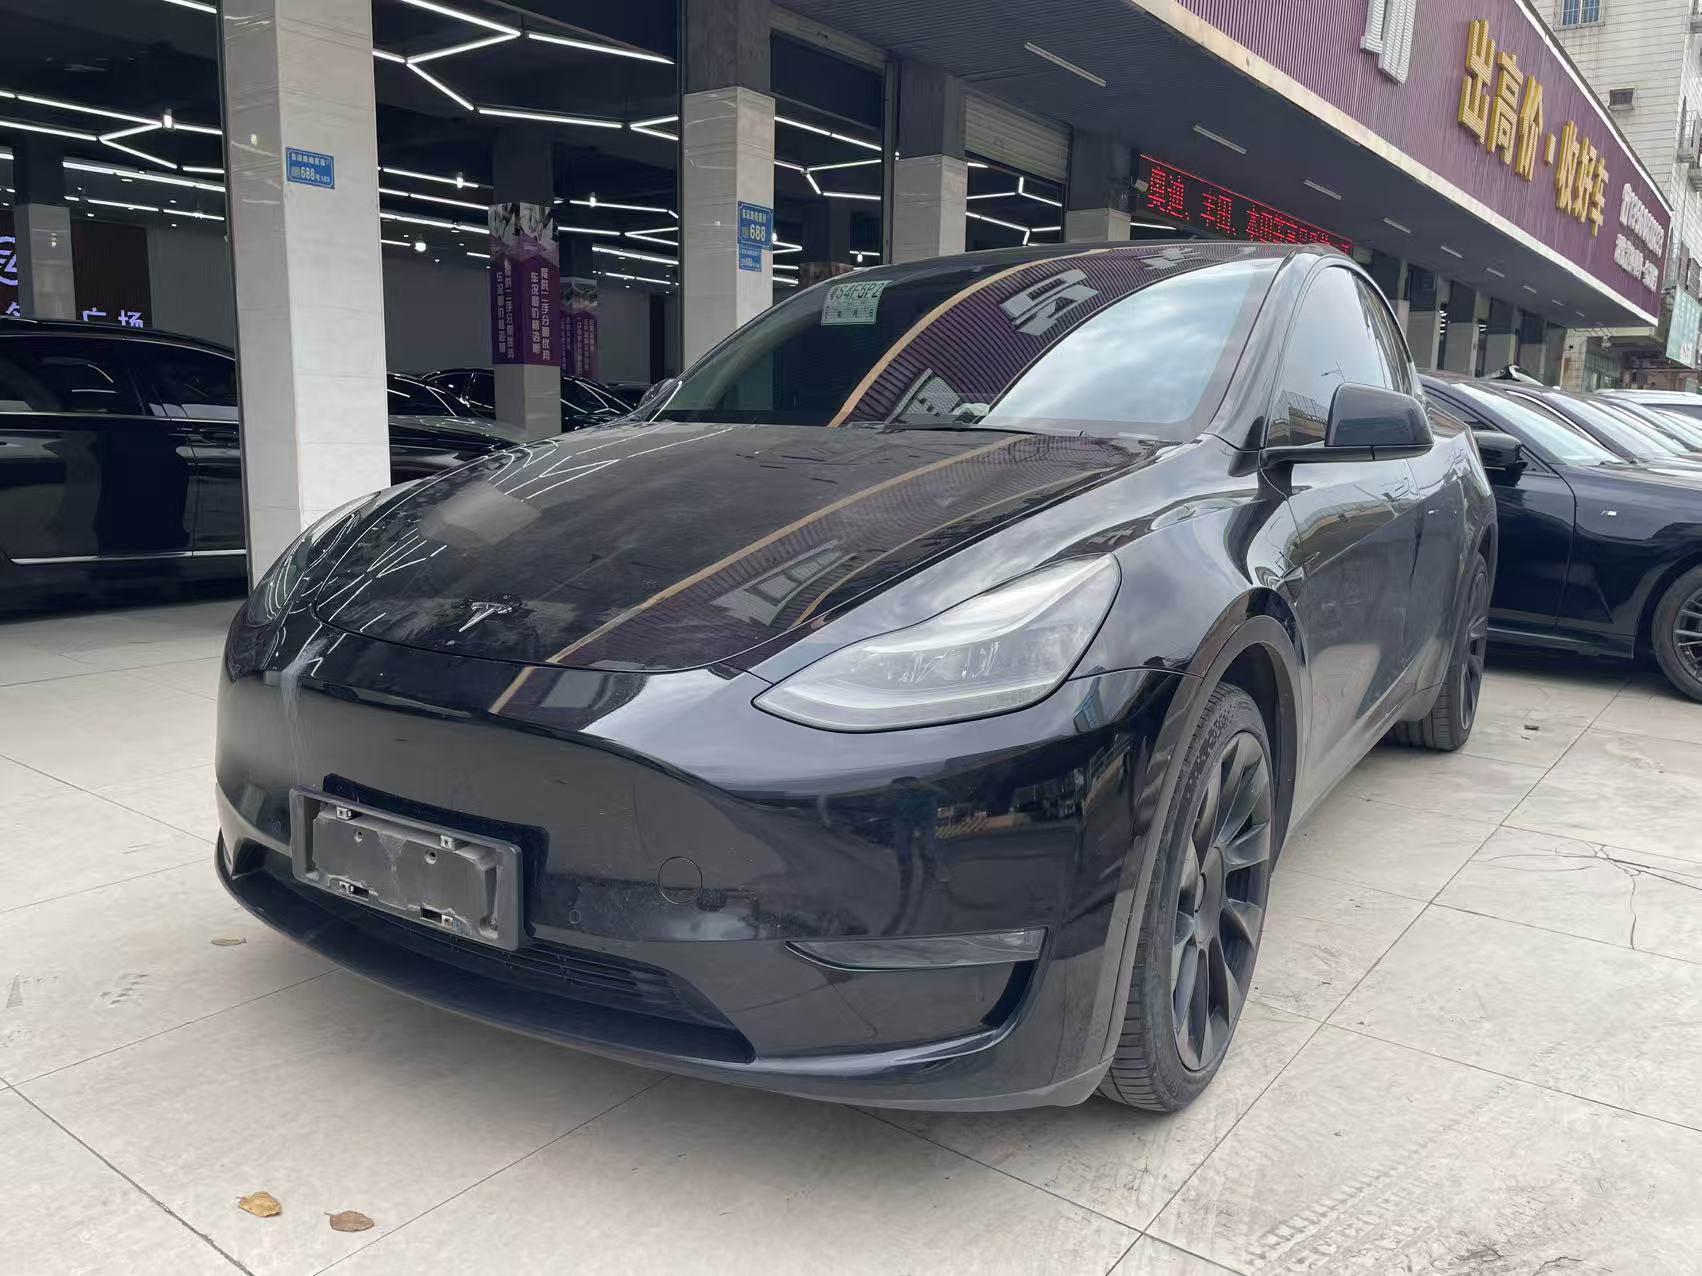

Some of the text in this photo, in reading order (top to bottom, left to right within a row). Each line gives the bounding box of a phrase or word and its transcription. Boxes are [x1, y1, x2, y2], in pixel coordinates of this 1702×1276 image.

[1459, 19, 1608, 238] 出高价·收好车
